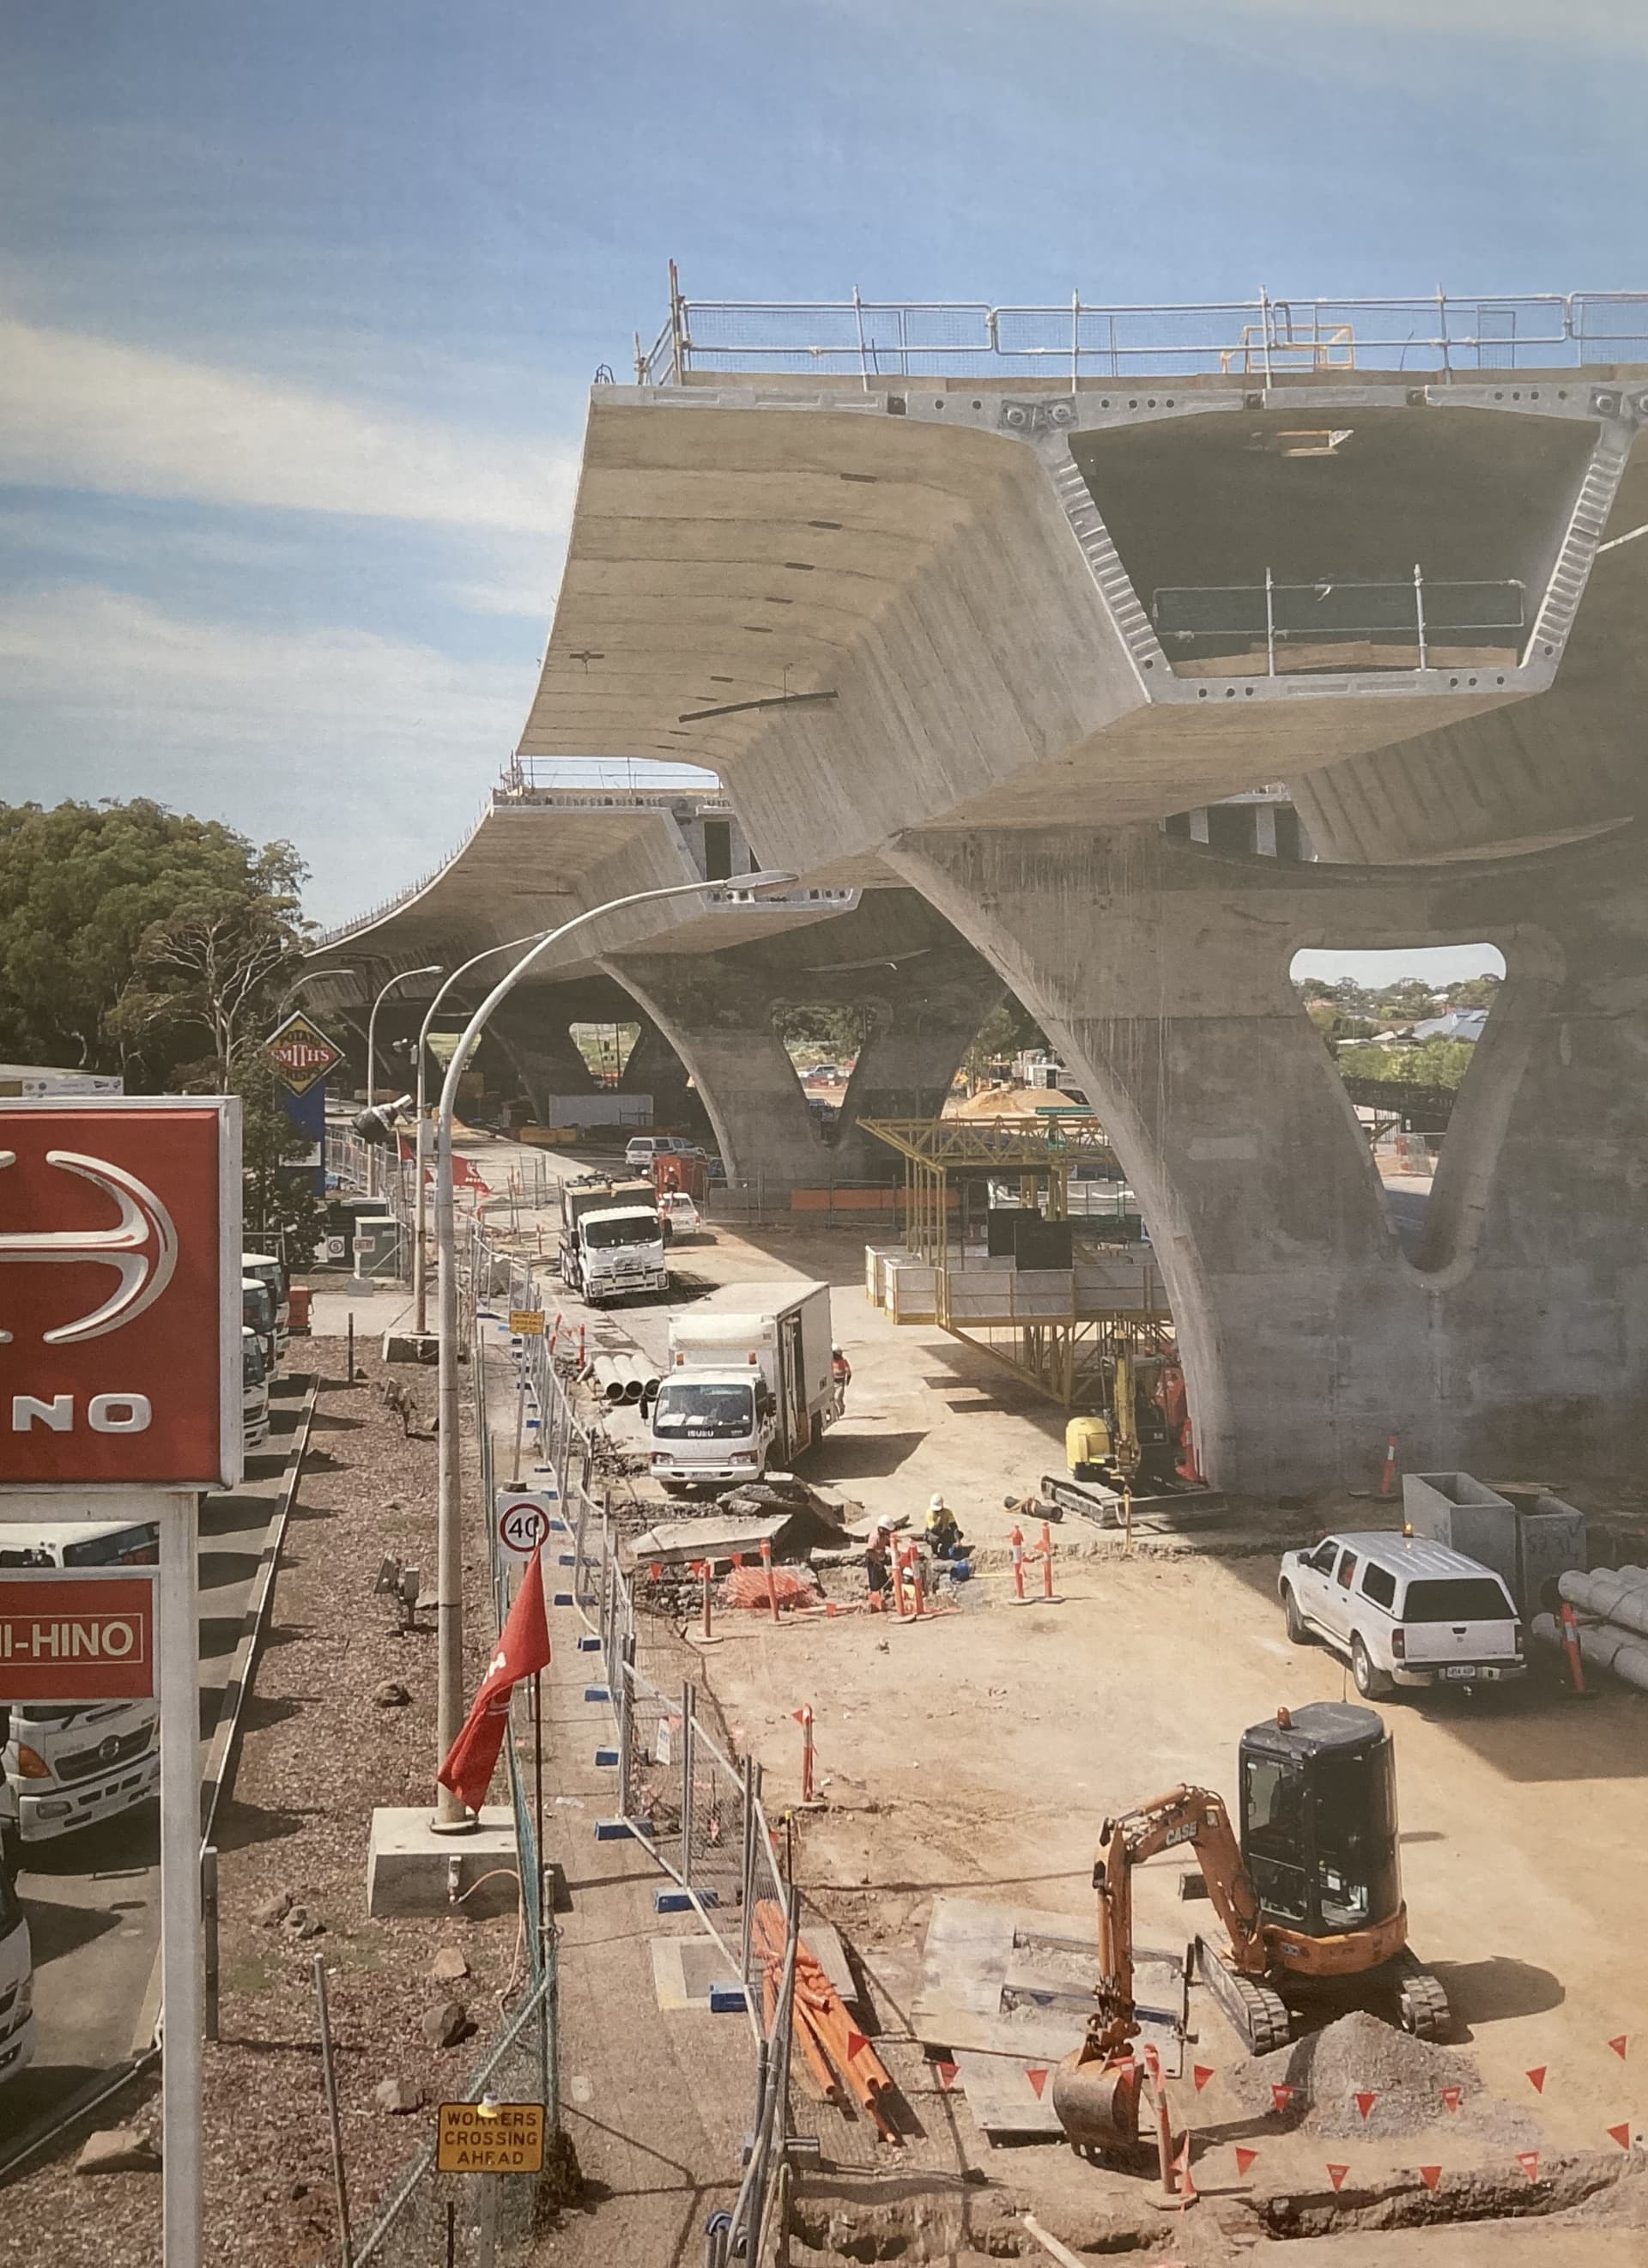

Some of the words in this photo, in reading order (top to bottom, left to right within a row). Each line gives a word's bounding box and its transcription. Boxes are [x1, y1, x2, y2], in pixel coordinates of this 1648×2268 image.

[508, 1517, 538, 1538] 40
[0, 1622, 134, 1657] I-HINO
[1166, 1820, 1197, 1846] CASE
[447, 2112, 536, 2126] WORKERS
[445, 2131, 537, 2145] CROSSING
[457, 2151, 524, 2165] AHEAD
